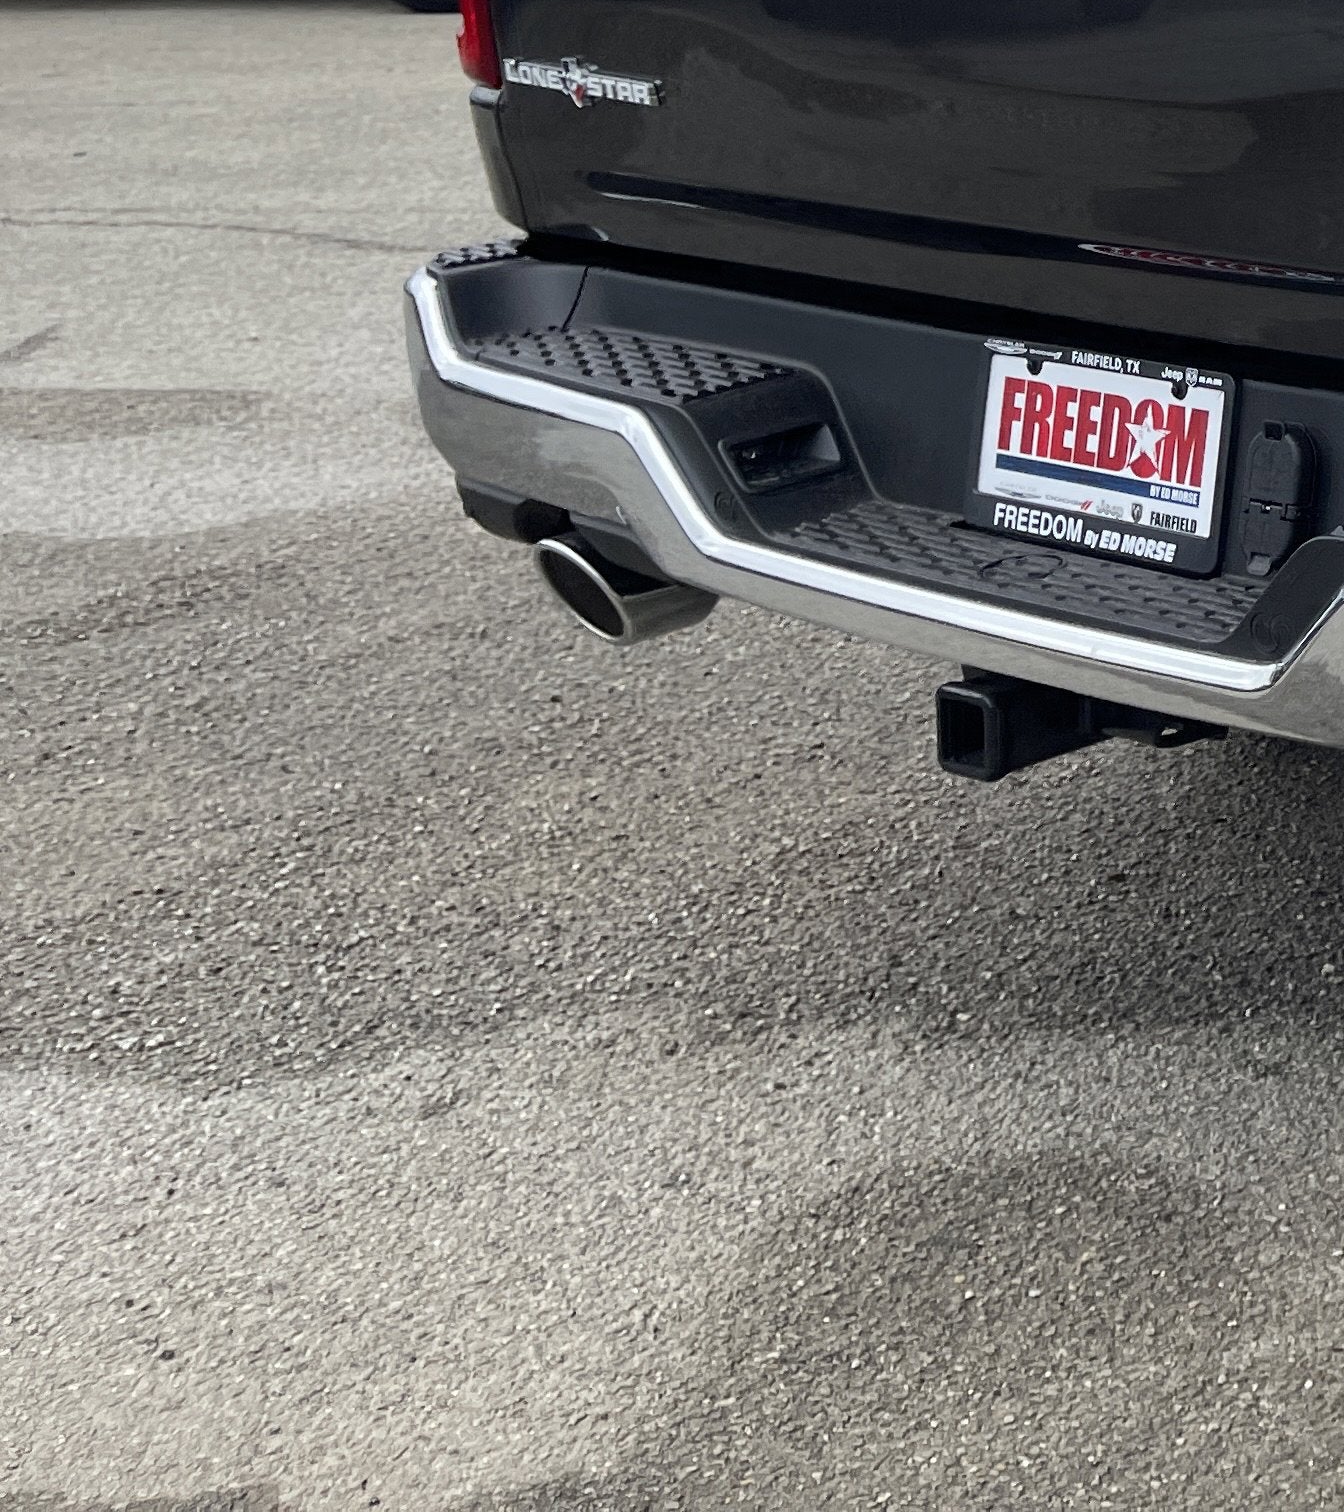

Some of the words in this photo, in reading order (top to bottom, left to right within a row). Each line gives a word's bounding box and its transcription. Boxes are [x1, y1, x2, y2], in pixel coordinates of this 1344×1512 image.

[503, 58, 564, 91] LONE
[586, 77, 659, 107] STAR
[1071, 350, 1123, 375] FAIRFIELD,
[1126, 359, 1141, 374] TX
[1161, 366, 1184, 383] Jeep
[997, 376, 1210, 488] FREEDOM
[1150, 484, 1161, 498] BY
[1161, 487, 1171, 500] ED
[1171, 489, 1199, 506] MORSE
[993, 502, 1084, 543] FREEDOM
[1099, 530, 1120, 551] ED
[1120, 534, 1177, 564] MORSE
[1150, 510, 1198, 534] FAIRFIELD
